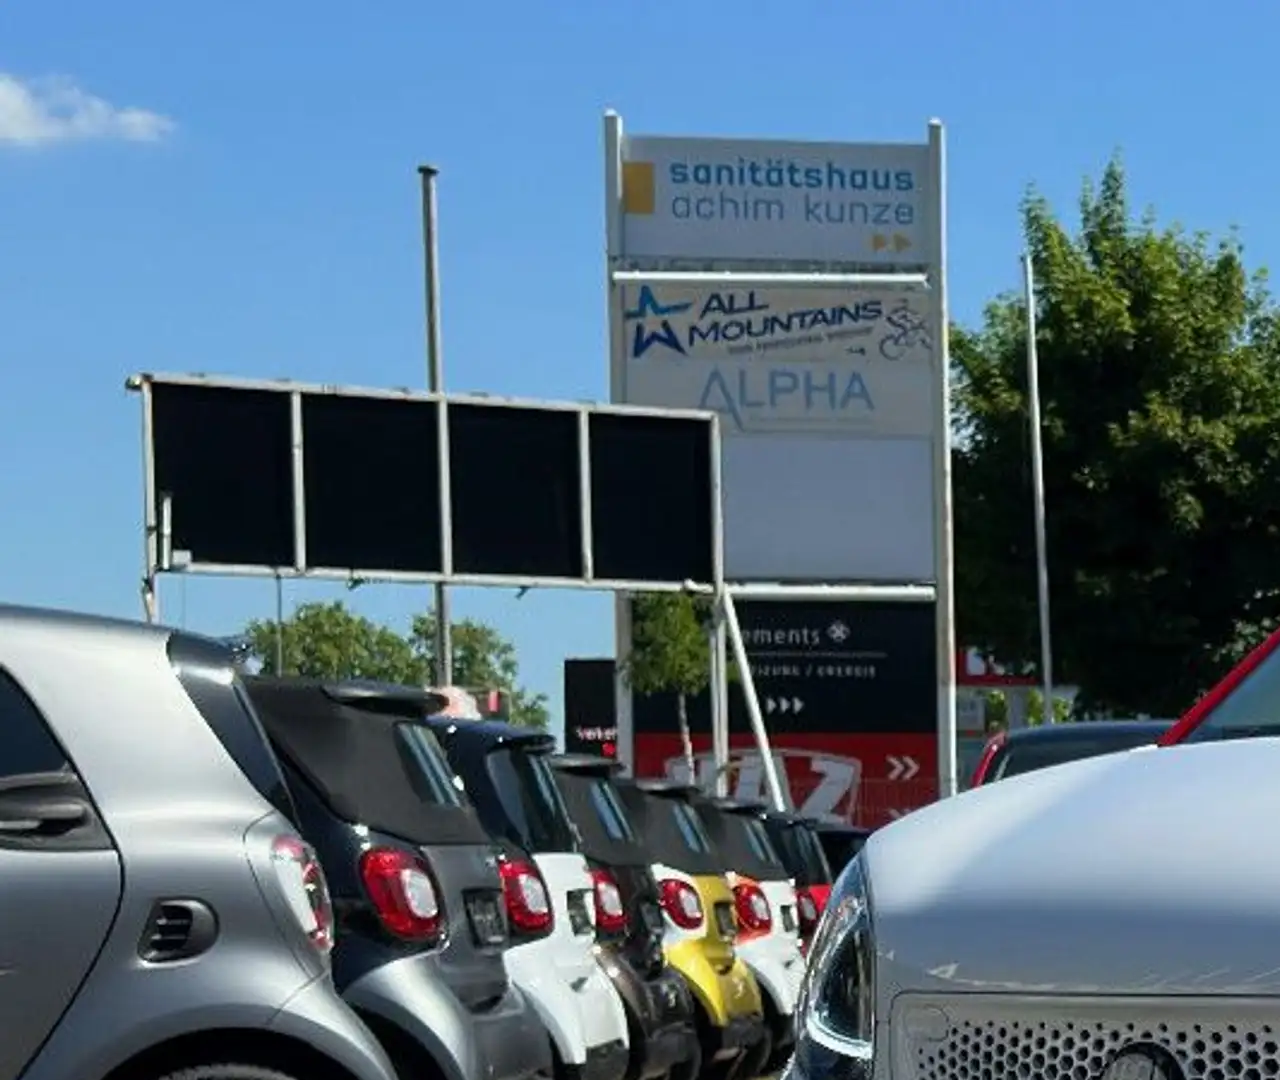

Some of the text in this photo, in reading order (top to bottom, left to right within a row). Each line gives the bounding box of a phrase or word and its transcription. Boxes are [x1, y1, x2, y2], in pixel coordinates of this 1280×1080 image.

[669, 157, 915, 192] sanitätshaus
[671, 194, 915, 225] achim kunze
[699, 291, 770, 320] ALL
[688, 301, 883, 347] MOUNTAINS
[698, 364, 875, 425] ALPHA
